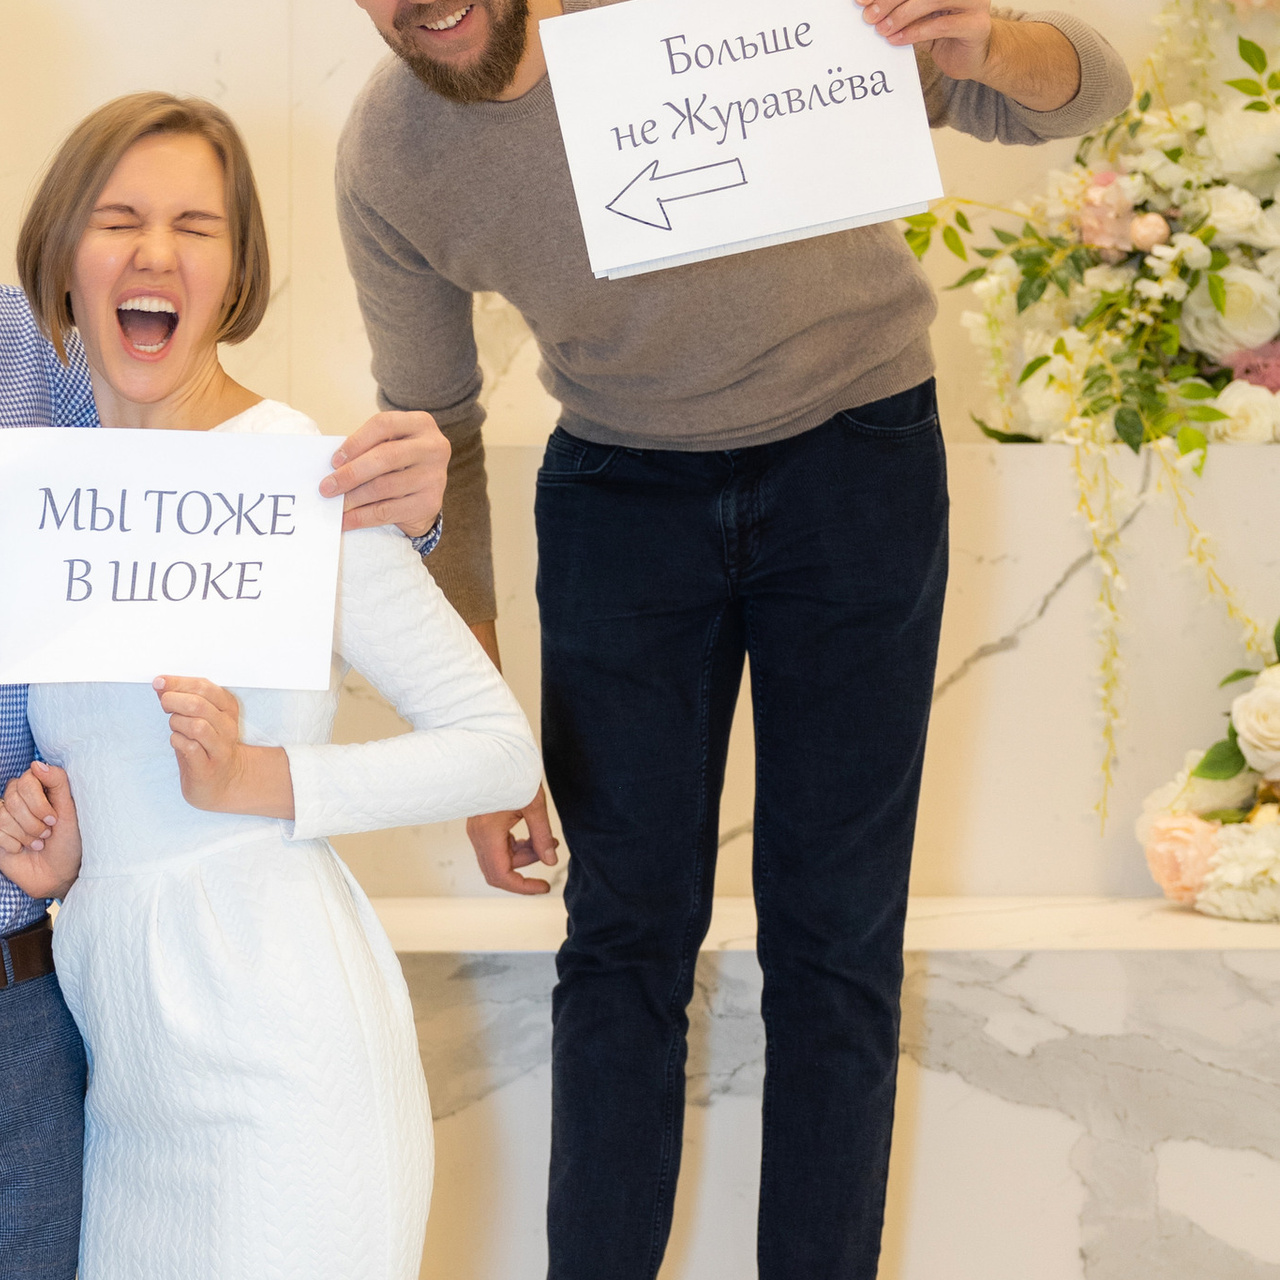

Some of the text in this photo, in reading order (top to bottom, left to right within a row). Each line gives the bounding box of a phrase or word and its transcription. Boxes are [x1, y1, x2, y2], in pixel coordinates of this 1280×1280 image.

[659, 21, 814, 76] Больше
[609, 66, 895, 152] не Журавлёва
[38, 487, 296, 536] МЫ ТОЖЕ
[63, 558, 263, 602] В ШОКЕ
